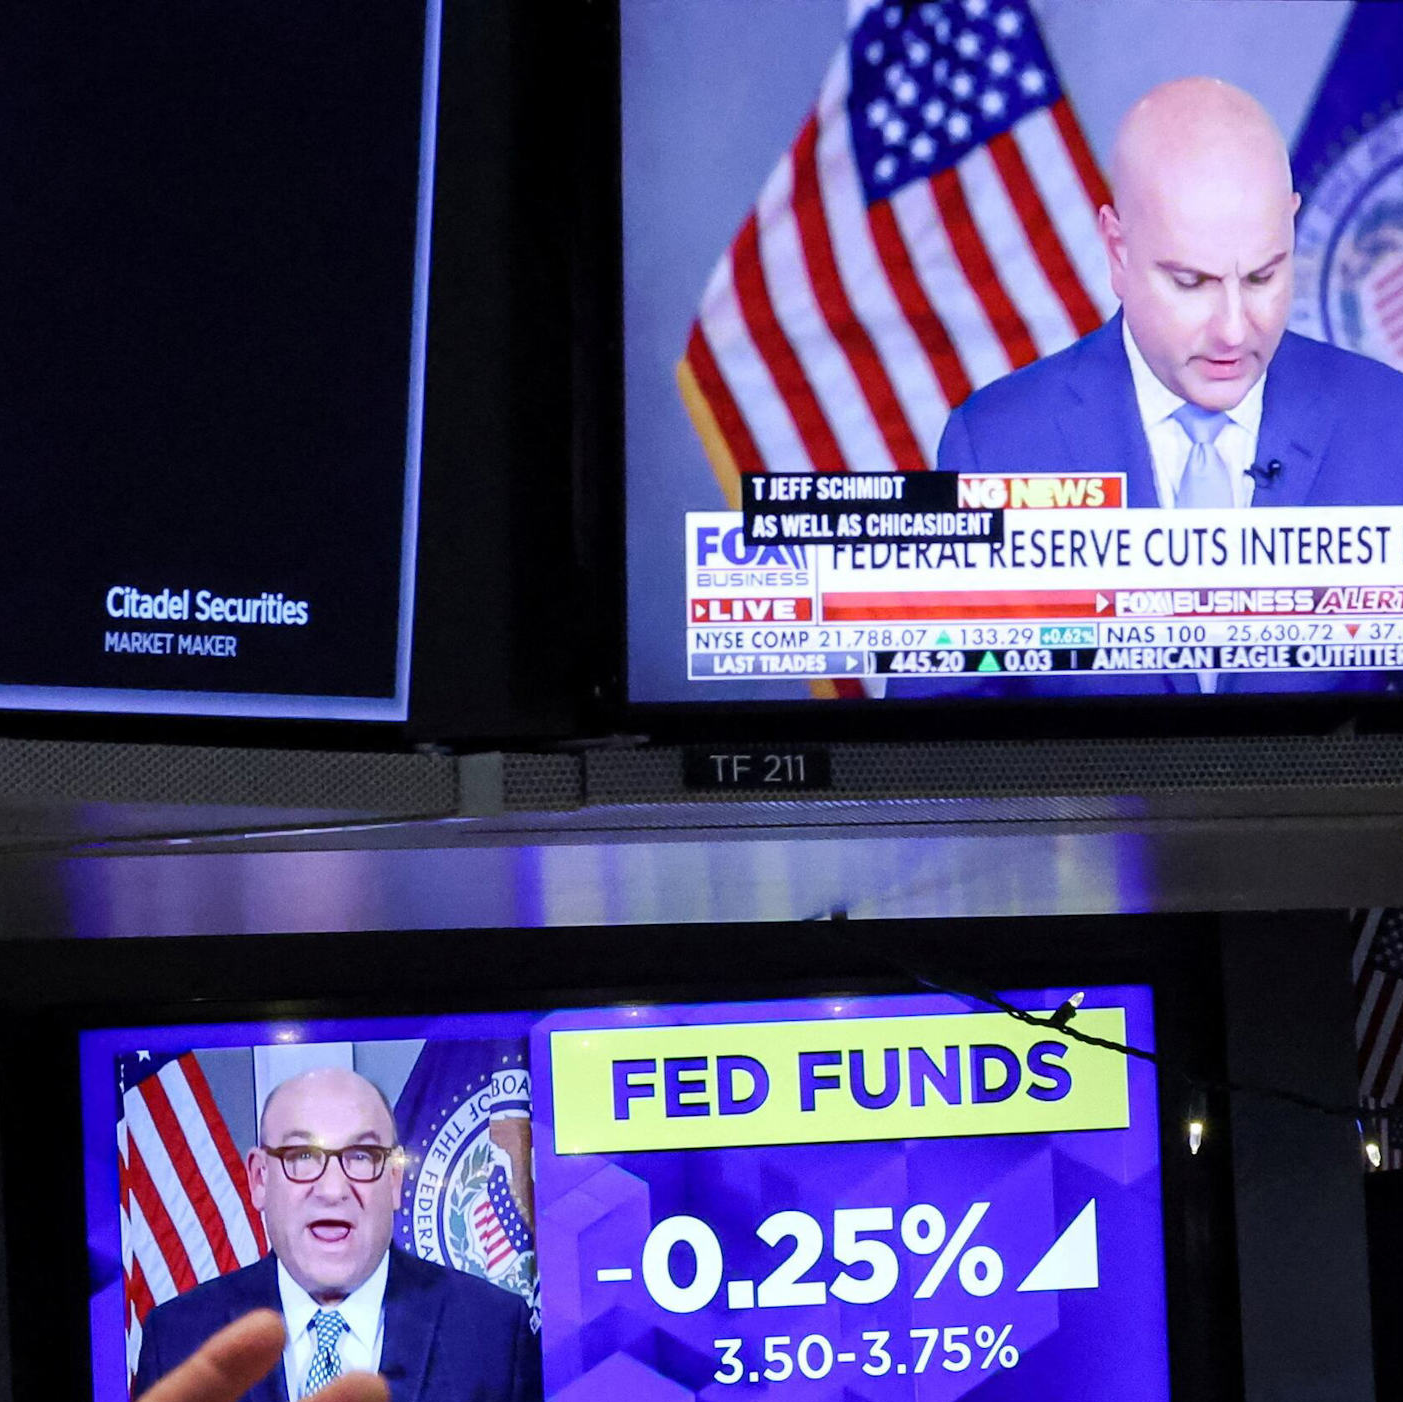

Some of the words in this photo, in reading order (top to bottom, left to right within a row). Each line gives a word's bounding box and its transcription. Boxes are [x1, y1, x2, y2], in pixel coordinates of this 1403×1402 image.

[769, 477, 812, 500] JEFF
[816, 476, 905, 500] SCHMIDT
[1009, 478, 1106, 507] NEWS
[752, 514, 778, 538] AS
[780, 513, 834, 537] WELL
[837, 513, 862, 537] AS
[865, 512, 993, 537] CHICASIDENT
[696, 526, 808, 570] FOX
[833, 542, 976, 569] FEDERAL
[990, 528, 1131, 568] RESERVE
[1144, 527, 1229, 567] CUTS
[1241, 526, 1391, 565] INTEREST
[696, 572, 809, 588] BUSINESS
[106, 586, 190, 620] Citadel
[195, 589, 309, 626] Securities
[708, 599, 796, 621] LIVE
[105, 631, 175, 654] MARKET
[178, 633, 237, 657] MAKER
[695, 631, 744, 649] NYSE
[751, 630, 810, 649] COMP
[960, 627, 1034, 646] 133.29
[1107, 626, 1156, 644] NAS
[1166, 624, 1206, 643] 100
[713, 653, 755, 673] LAST
[758, 652, 827, 673] TRADES
[889, 651, 966, 672] 445.20
[1003, 650, 1053, 672] 0.03
[1092, 646, 1215, 671] AMERICAN
[1220, 646, 1291, 668] EAGLE
[710, 755, 752, 783] TF
[763, 754, 806, 783] 211
[611, 1054, 770, 1121] FED
[799, 1040, 1073, 1112] FUNDS
[417, 1169, 439, 1263] FEDERA
[597, 1201, 1003, 1314] -0.25%
[714, 1324, 1019, 1384] 3.50-3.75%
